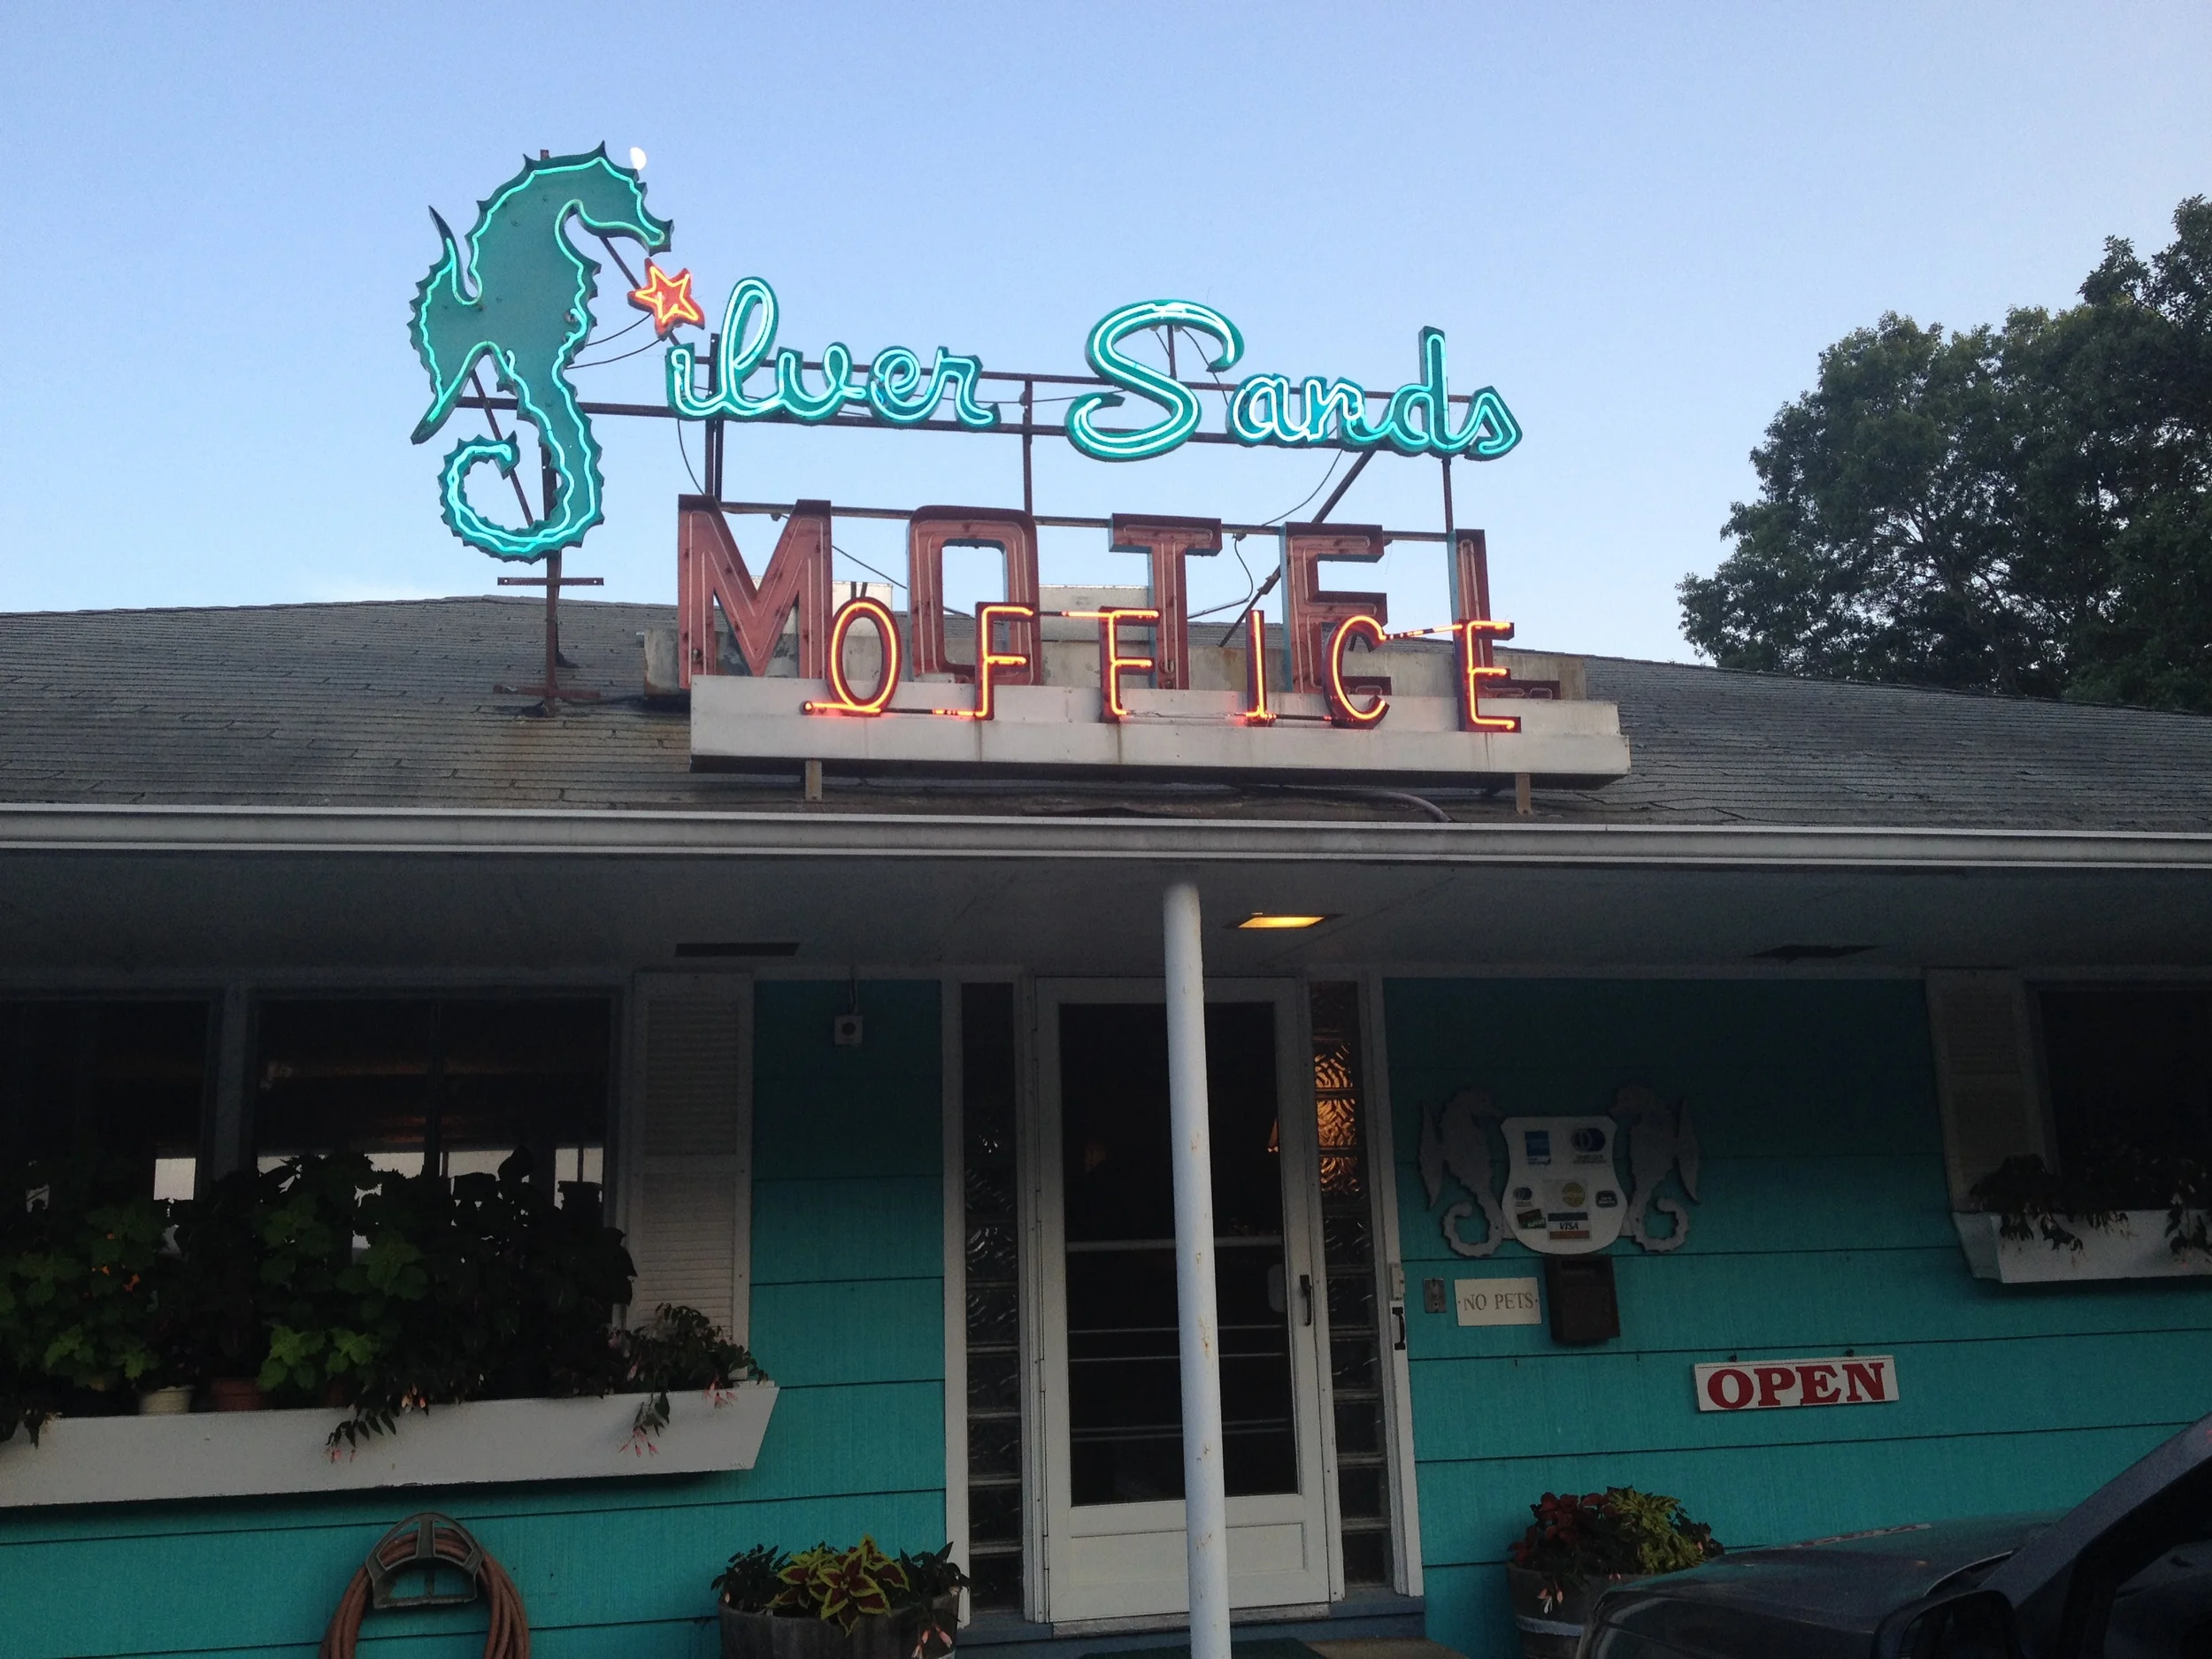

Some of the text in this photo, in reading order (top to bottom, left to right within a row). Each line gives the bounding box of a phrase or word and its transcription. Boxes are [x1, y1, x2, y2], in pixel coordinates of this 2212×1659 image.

[1065, 299, 1523, 460] Sands
[678, 495, 1560, 697] MOTEL
[825, 595, 1523, 731] OFFICE
[1559, 1221, 1579, 1231] VISA
[1463, 1291, 1533, 1310] NO PETS
[1707, 1363, 1886, 1409] OPEN
